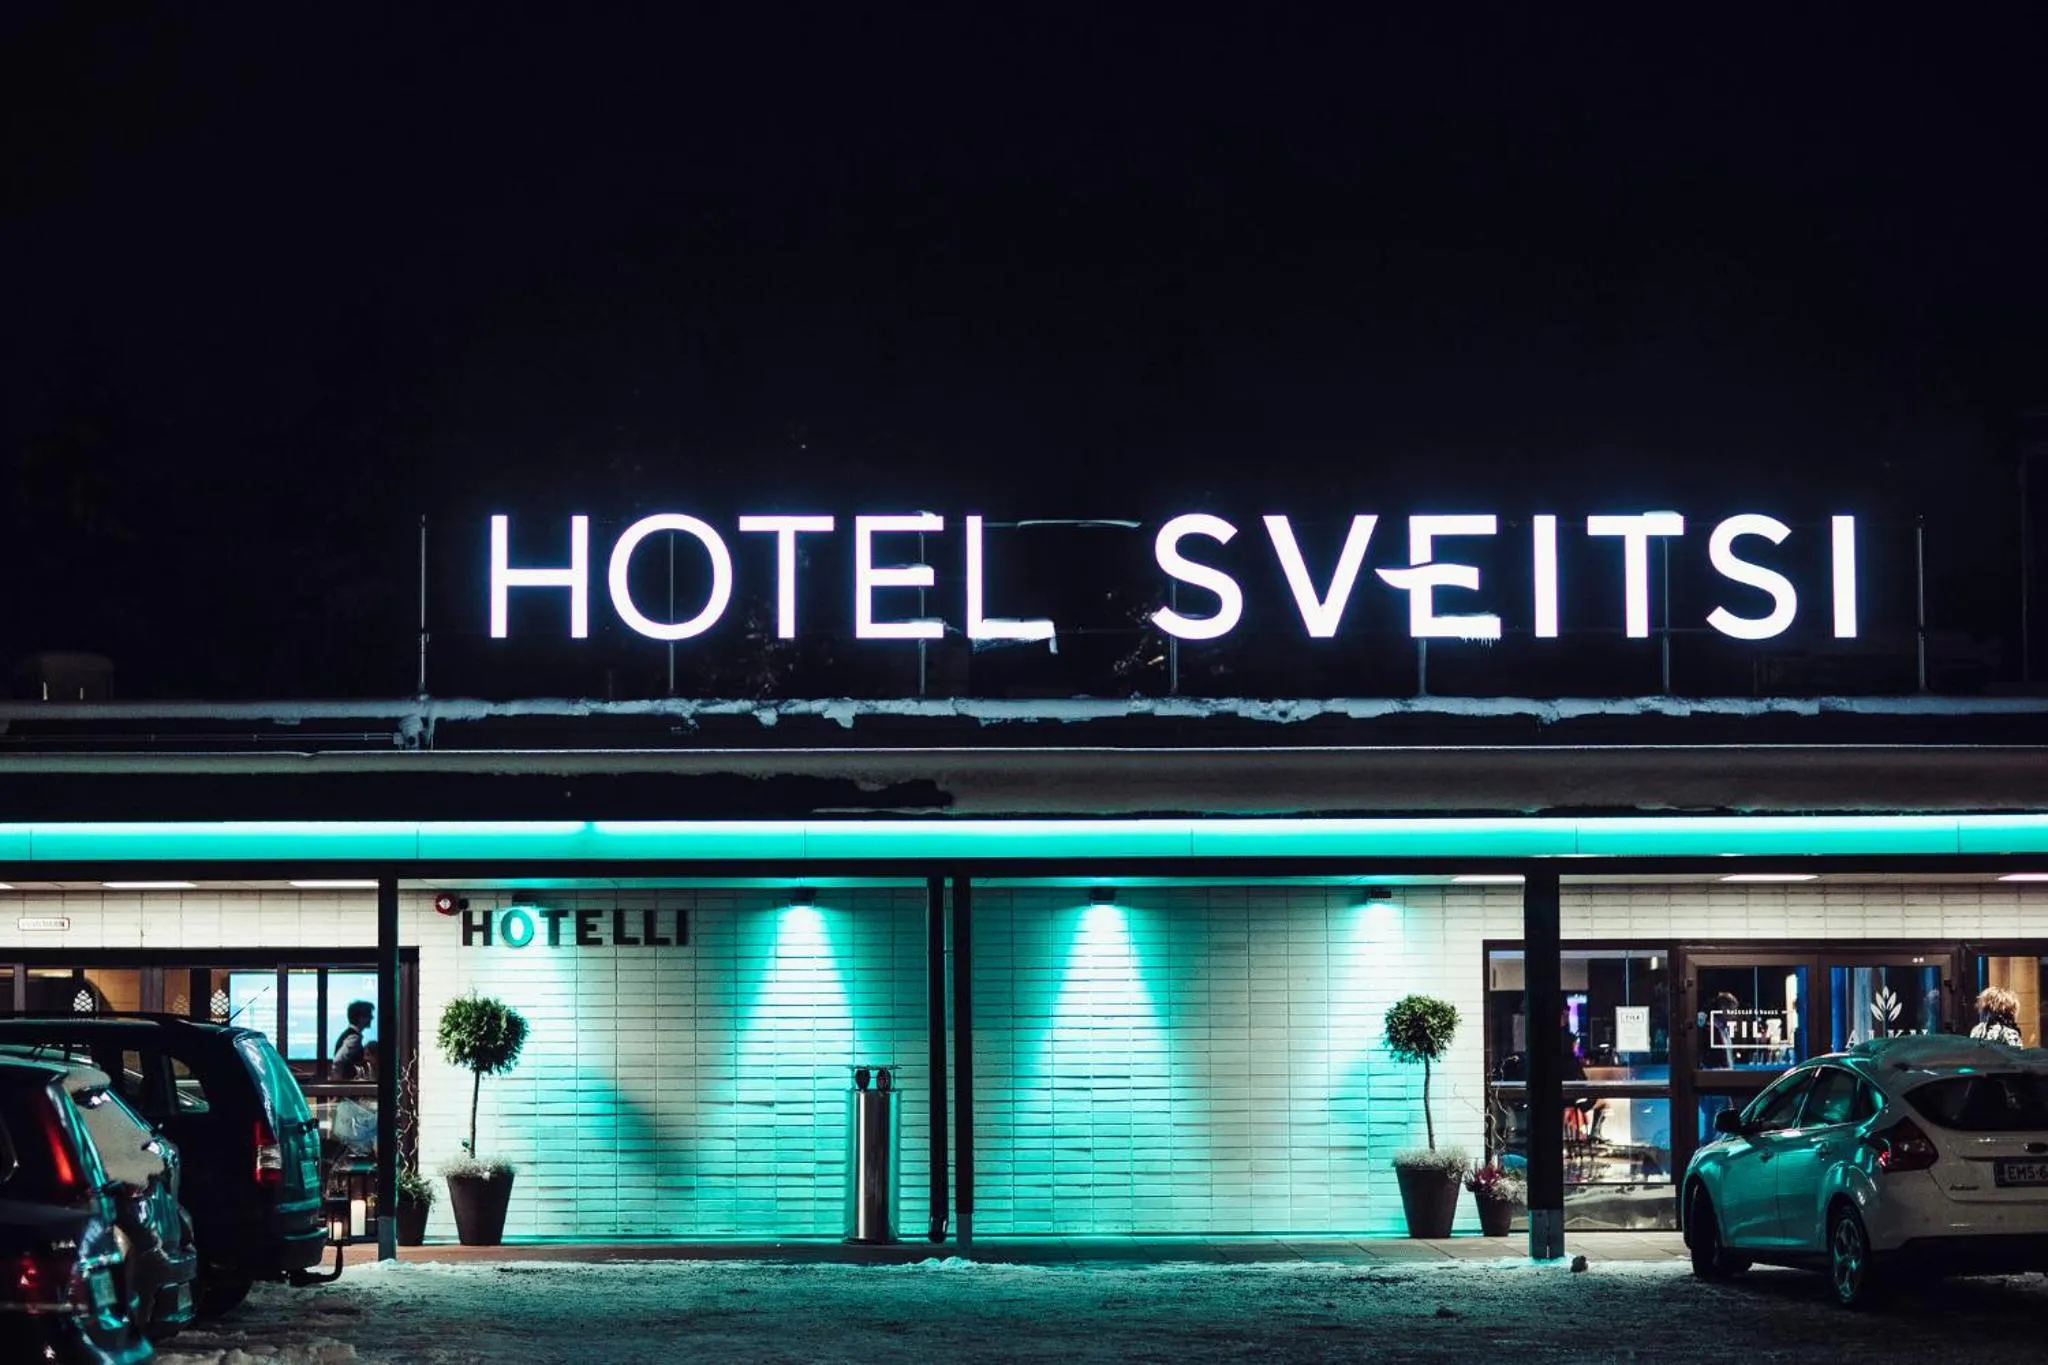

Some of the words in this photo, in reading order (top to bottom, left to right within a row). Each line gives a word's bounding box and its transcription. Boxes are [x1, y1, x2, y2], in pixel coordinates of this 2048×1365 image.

[489, 512, 1056, 641] HOTEL
[1151, 511, 1858, 641] SVEITSI
[462, 907, 688, 947] HOTELLI
